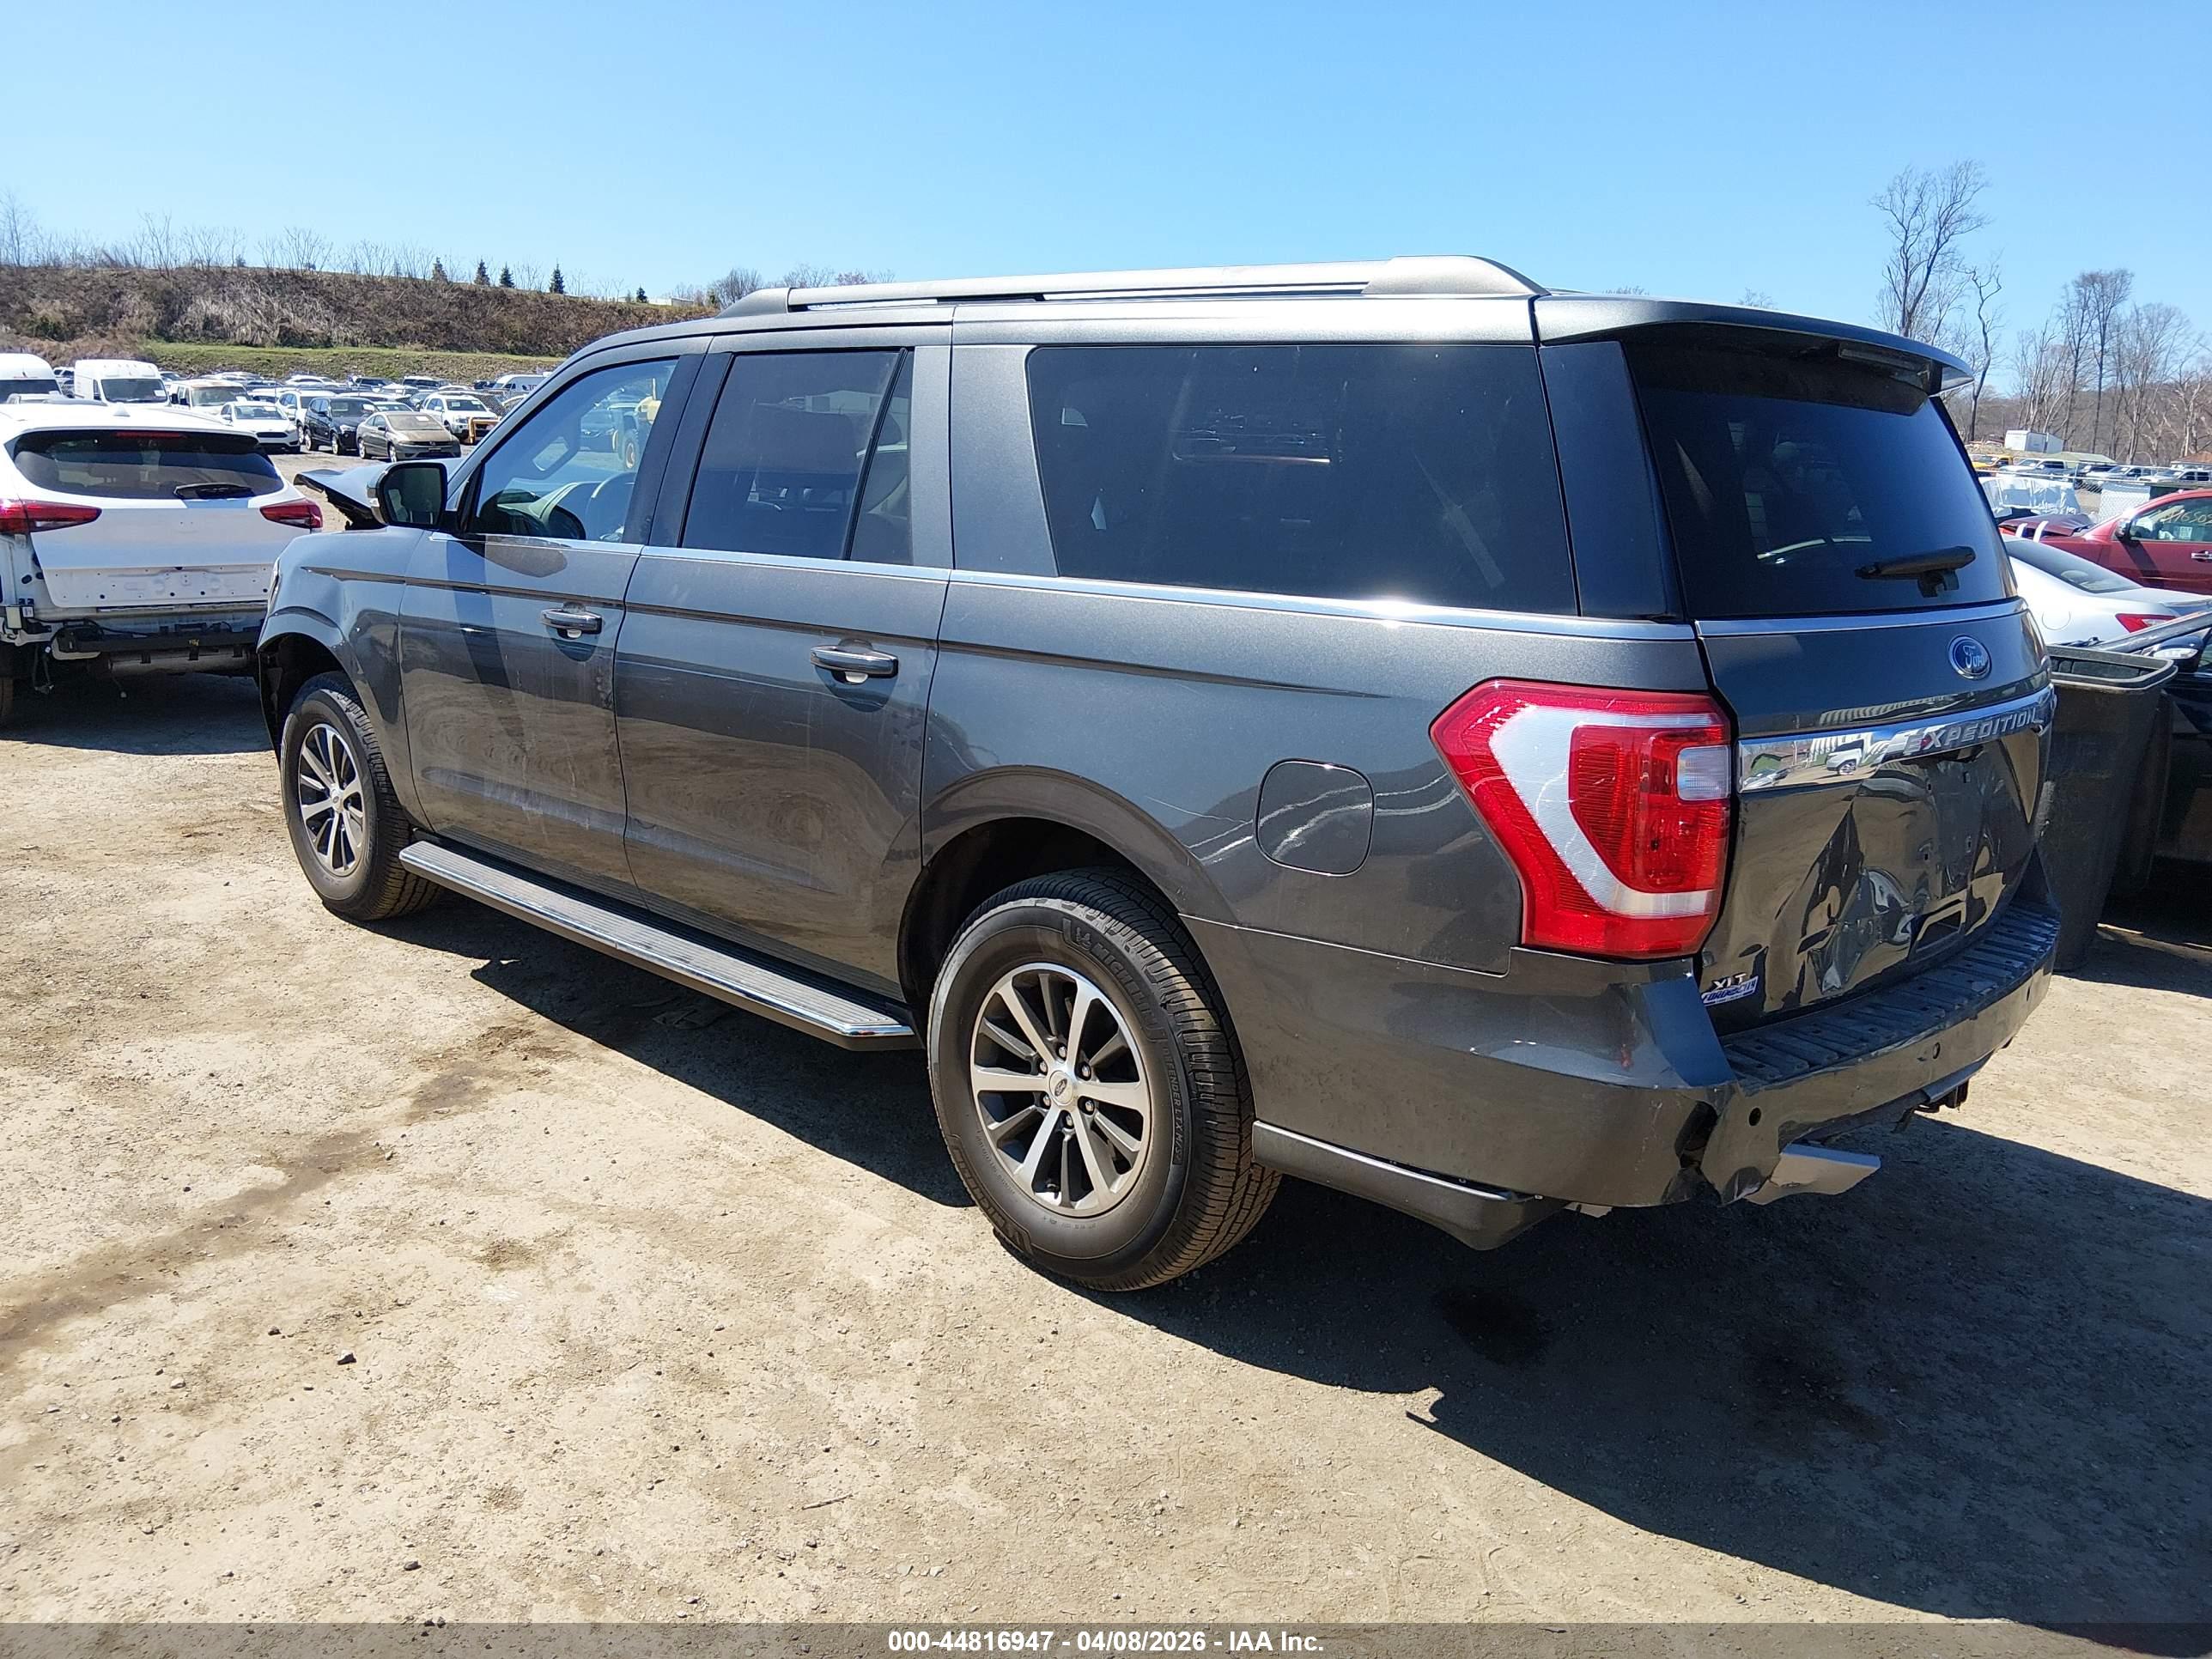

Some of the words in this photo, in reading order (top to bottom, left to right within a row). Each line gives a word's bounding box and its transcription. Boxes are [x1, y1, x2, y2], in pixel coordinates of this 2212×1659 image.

[1962, 645, 1987, 669] Ford
[1903, 707, 2044, 757] EXPEDITION
[1163, 1047, 1182, 1105] DEFENDER
[1174, 1108, 1183, 1132] LTX
